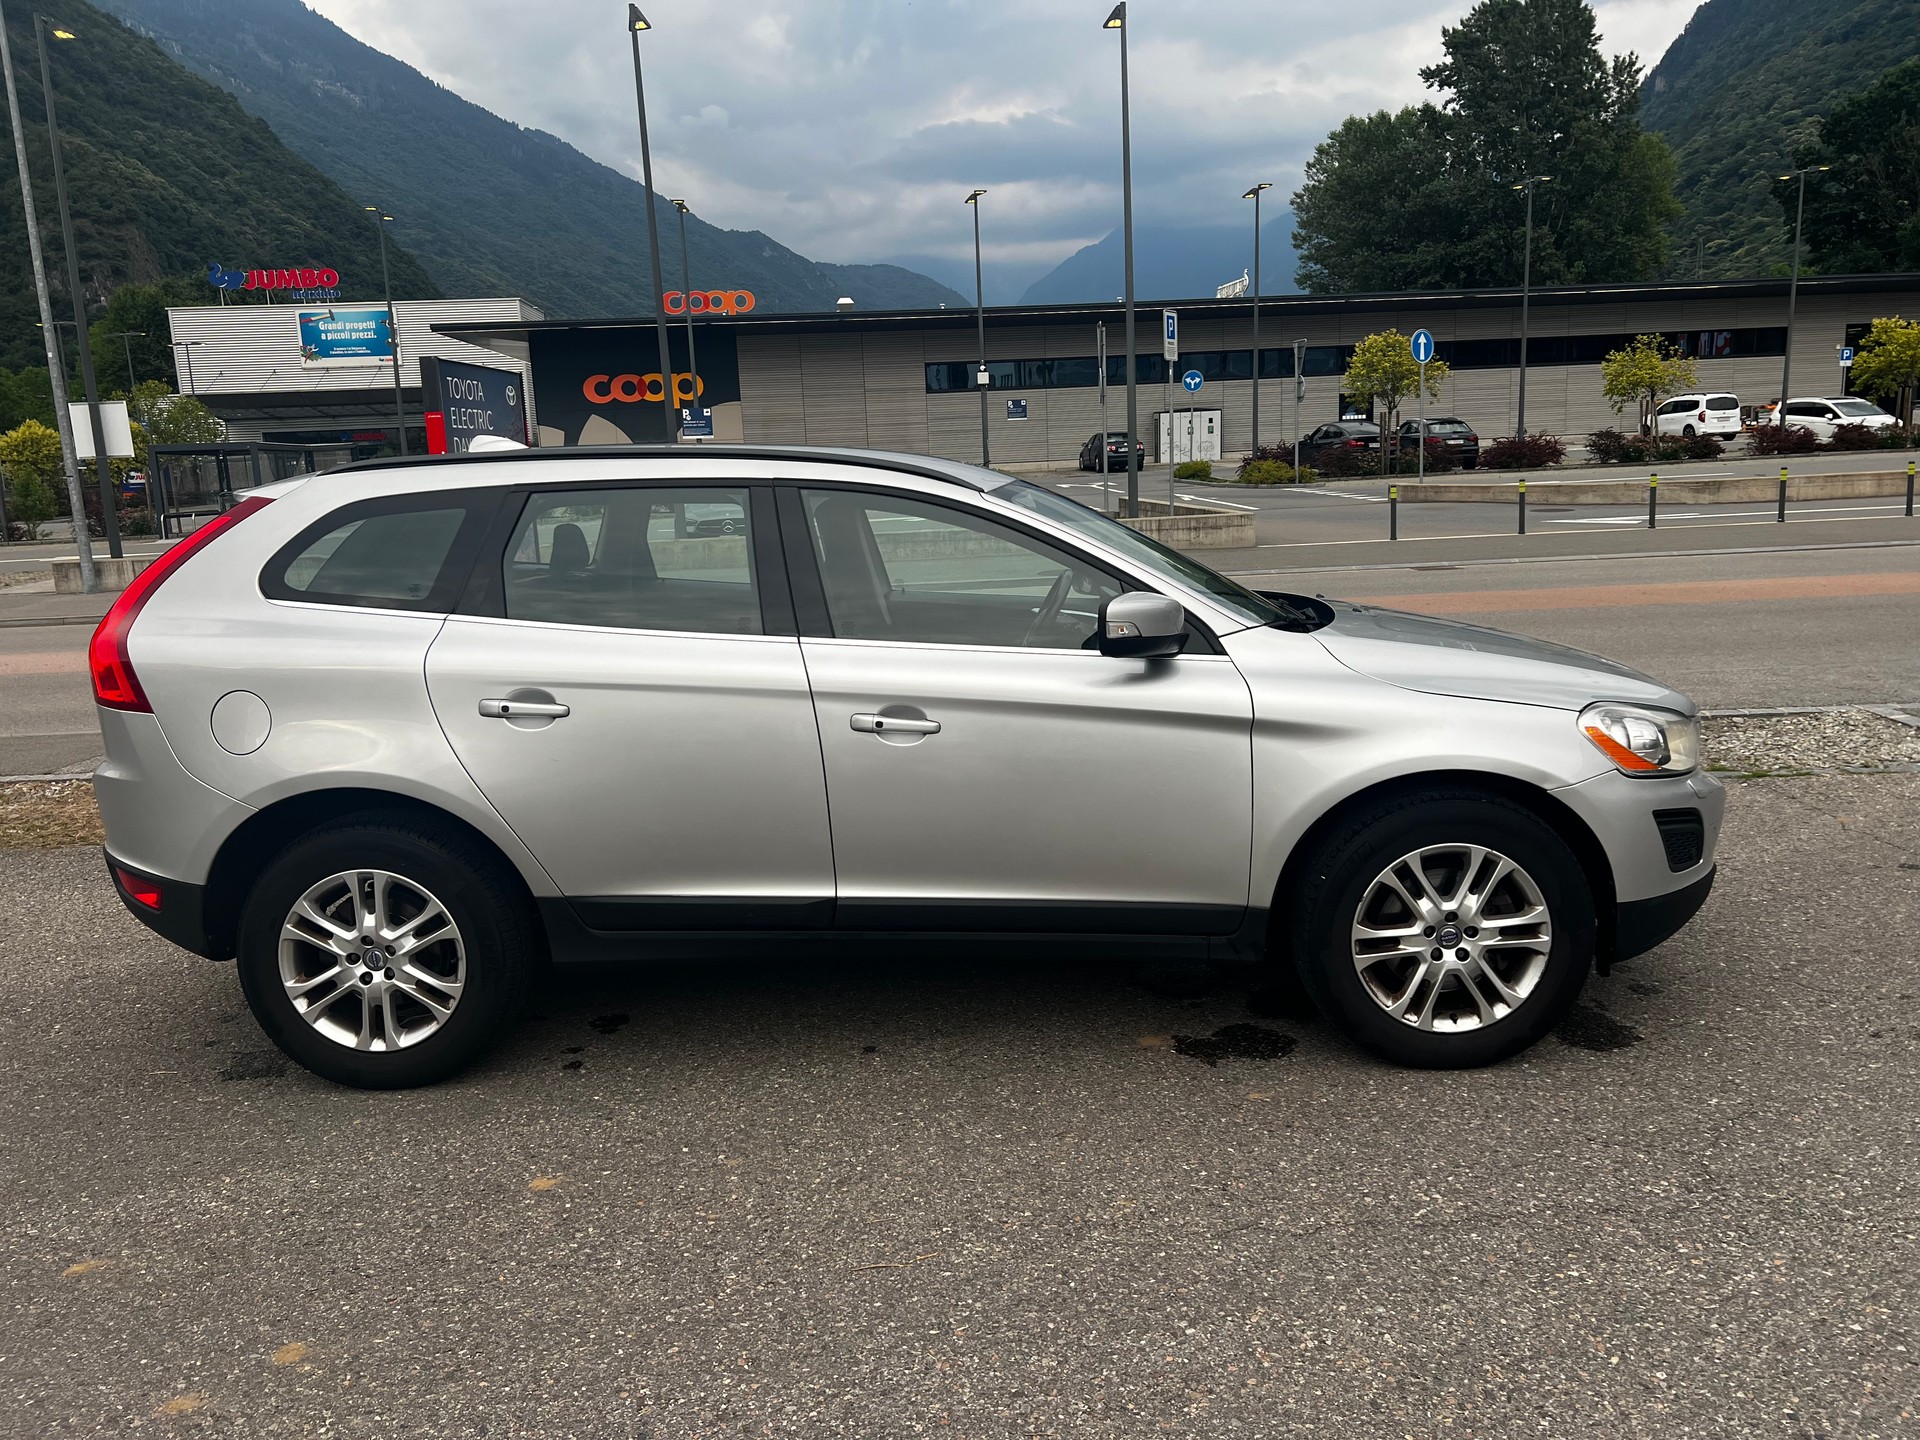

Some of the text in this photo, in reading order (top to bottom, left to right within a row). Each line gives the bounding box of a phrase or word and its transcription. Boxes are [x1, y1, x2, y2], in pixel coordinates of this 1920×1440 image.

[244, 268, 339, 290] JUMBO
[663, 290, 756, 315] coop
[319, 320, 376, 330] Grandi progetti
[327, 330, 350, 340] piccoli
[351, 330, 377, 339] prezzi.
[1168, 319, 1174, 337] P
[1843, 350, 1850, 360] P
[446, 376, 485, 402] TOYOTA
[583, 372, 704, 409] coop
[450, 407, 494, 431] ELECTRIC
